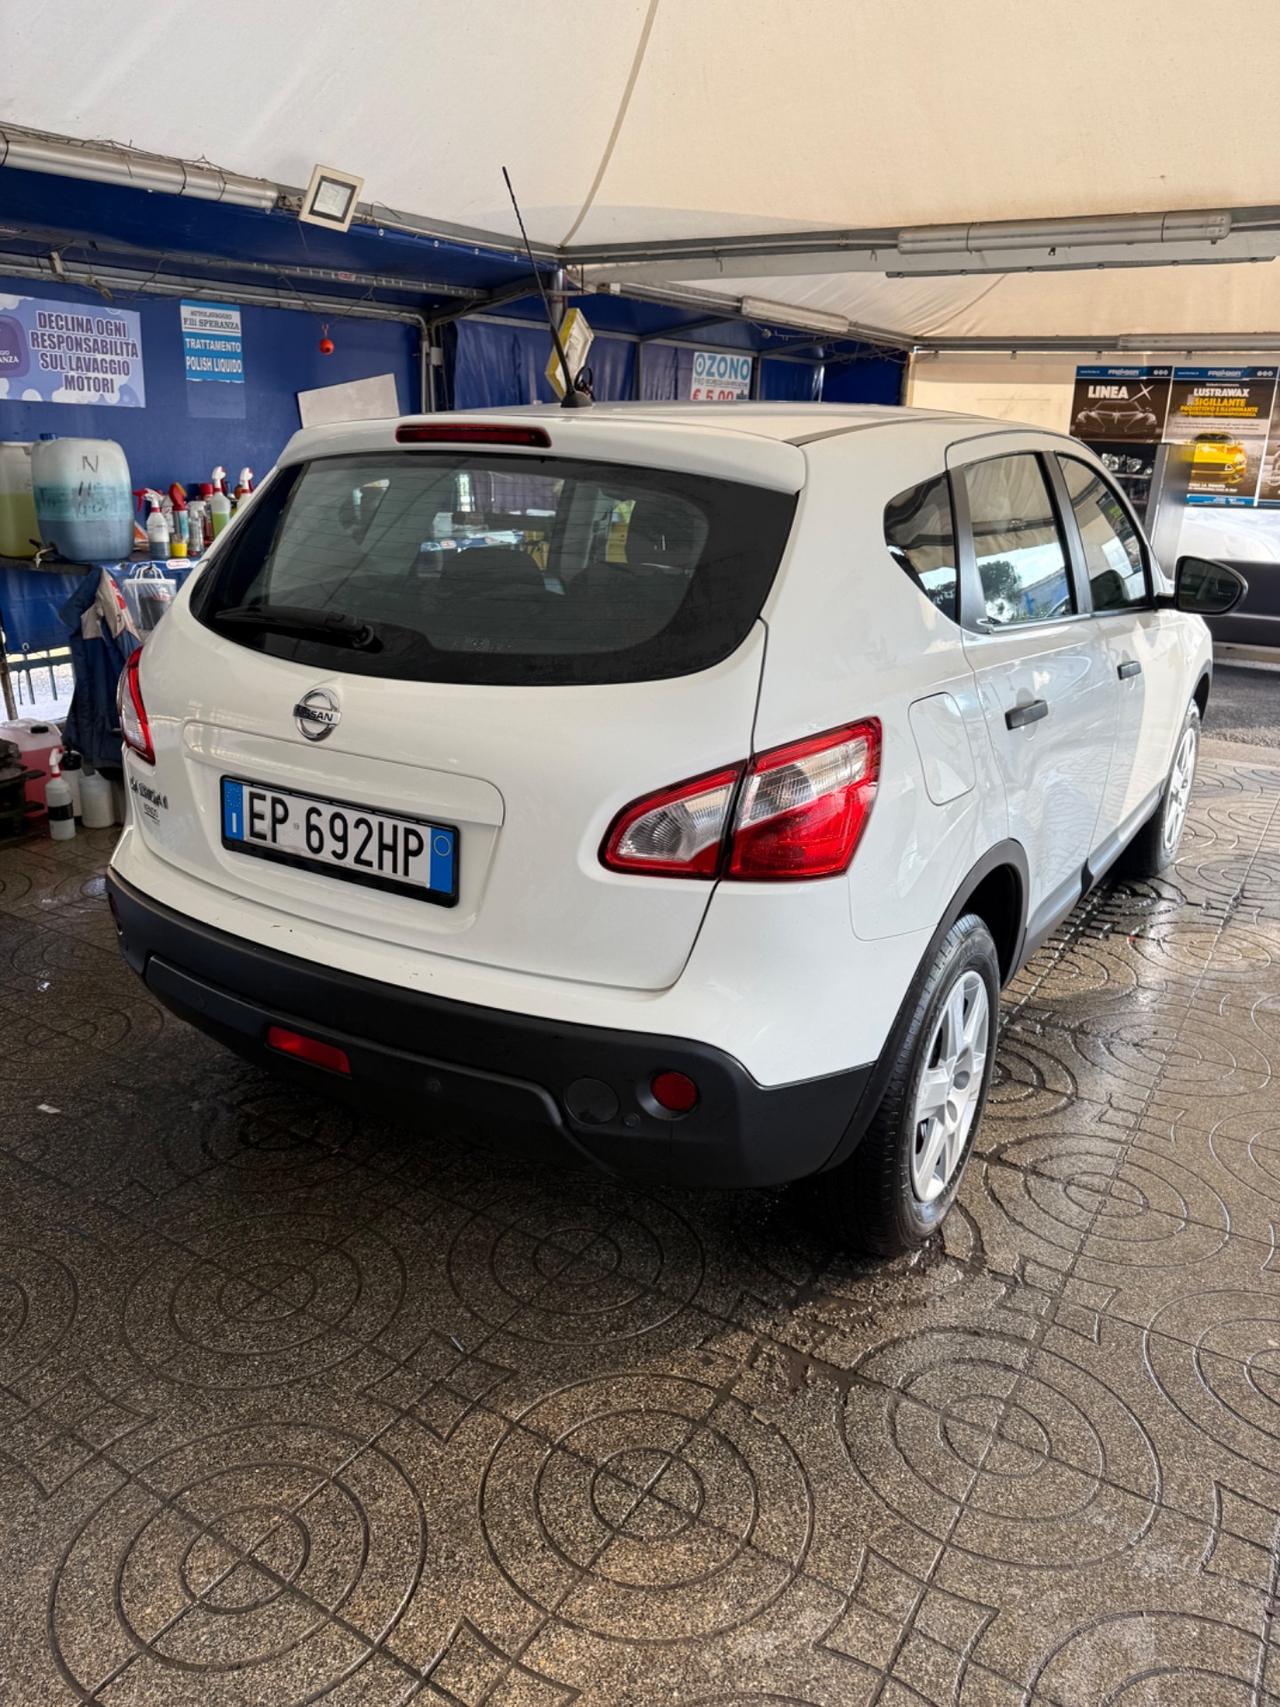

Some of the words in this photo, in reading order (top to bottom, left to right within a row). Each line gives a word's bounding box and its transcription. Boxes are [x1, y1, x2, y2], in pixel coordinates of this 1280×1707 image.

[37, 312, 93, 334] DECLINA
[97, 319, 127, 338] OGNI
[199, 318, 240, 330] SPERANZA
[31, 331, 138, 358] RESPONSABILITÀ
[184, 338, 242, 353] TRATTAMENTO
[40, 353, 66, 371] SUL
[68, 356, 130, 376] LAVAGGIO
[186, 355, 213, 371] POLISH
[213, 357, 242, 373] LIQUIDO
[694, 353, 750, 381] OZONO
[64, 375, 114, 394] MOTORI
[1088, 385, 1129, 399] LINEA
[1128, 383, 1155, 401] X
[1193, 388, 1250, 398] LUSTRAWAX
[1193, 397, 1247, 407] SIGILLANTE
[295, 704, 334, 722] SSAN
[249, 791, 289, 844] EP
[305, 806, 424, 877] 692HP
